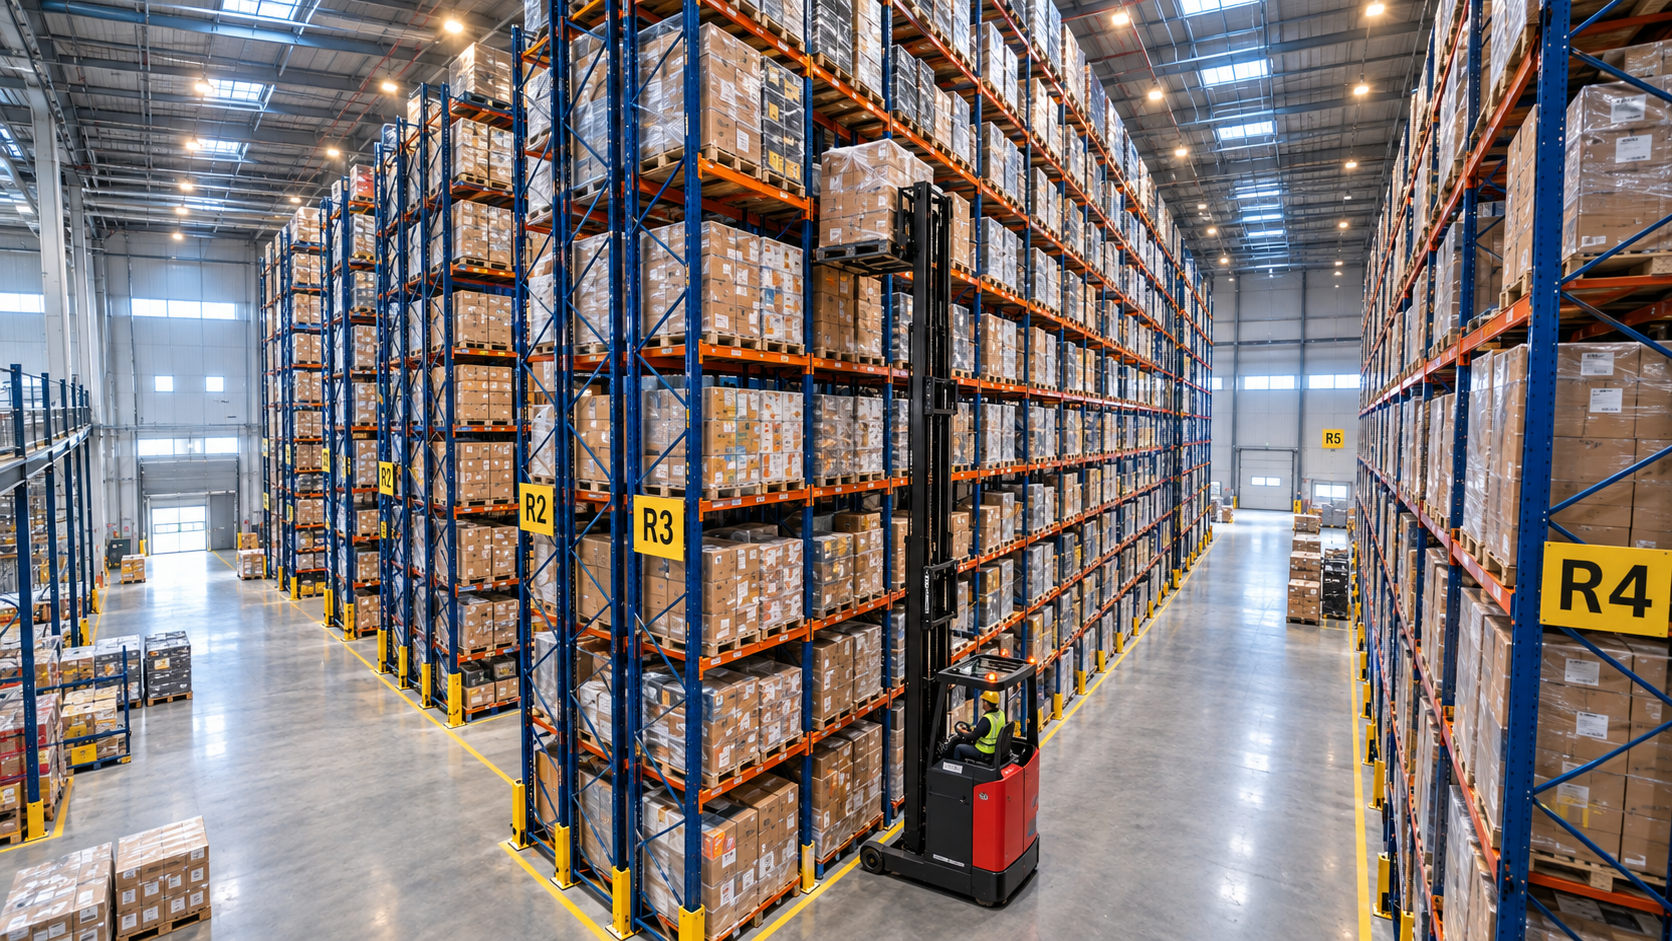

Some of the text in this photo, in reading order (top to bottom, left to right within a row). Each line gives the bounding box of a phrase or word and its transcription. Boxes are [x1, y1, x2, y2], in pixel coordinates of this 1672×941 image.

[1326, 432, 1341, 444] R5
[381, 467, 392, 488] R2
[525, 492, 547, 524] R2
[643, 507, 674, 545] R3
[1560, 558, 1653, 618] R4
